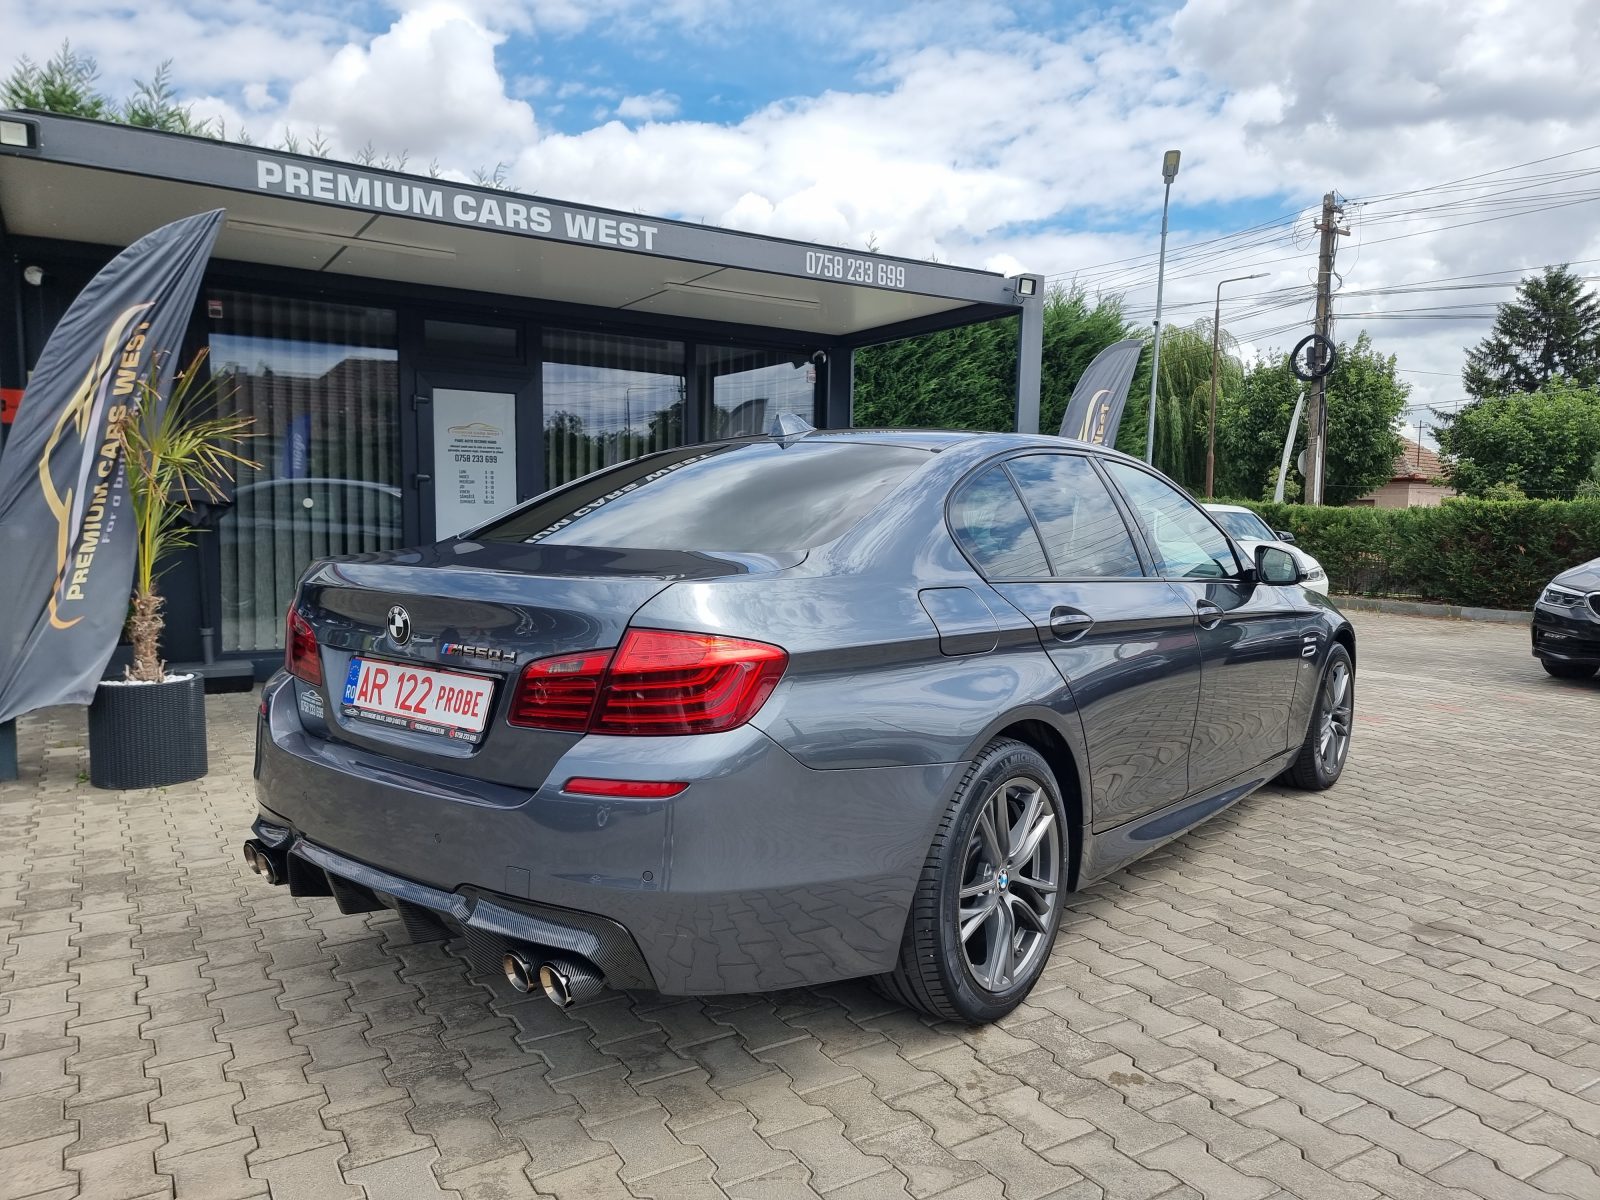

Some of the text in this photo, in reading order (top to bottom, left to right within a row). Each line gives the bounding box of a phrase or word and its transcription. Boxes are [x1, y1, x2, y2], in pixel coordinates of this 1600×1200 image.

[257, 160, 658, 250] PREMIUM CARS WEST
[806, 251, 905, 288] 0758 233 699
[454, 454, 498, 464] 0758 233 699
[66, 482, 109, 601] PREMIUM
[97, 404, 127, 478] CARS
[346, 684, 356, 699] RO
[357, 666, 484, 718] AR 122 PROBE
